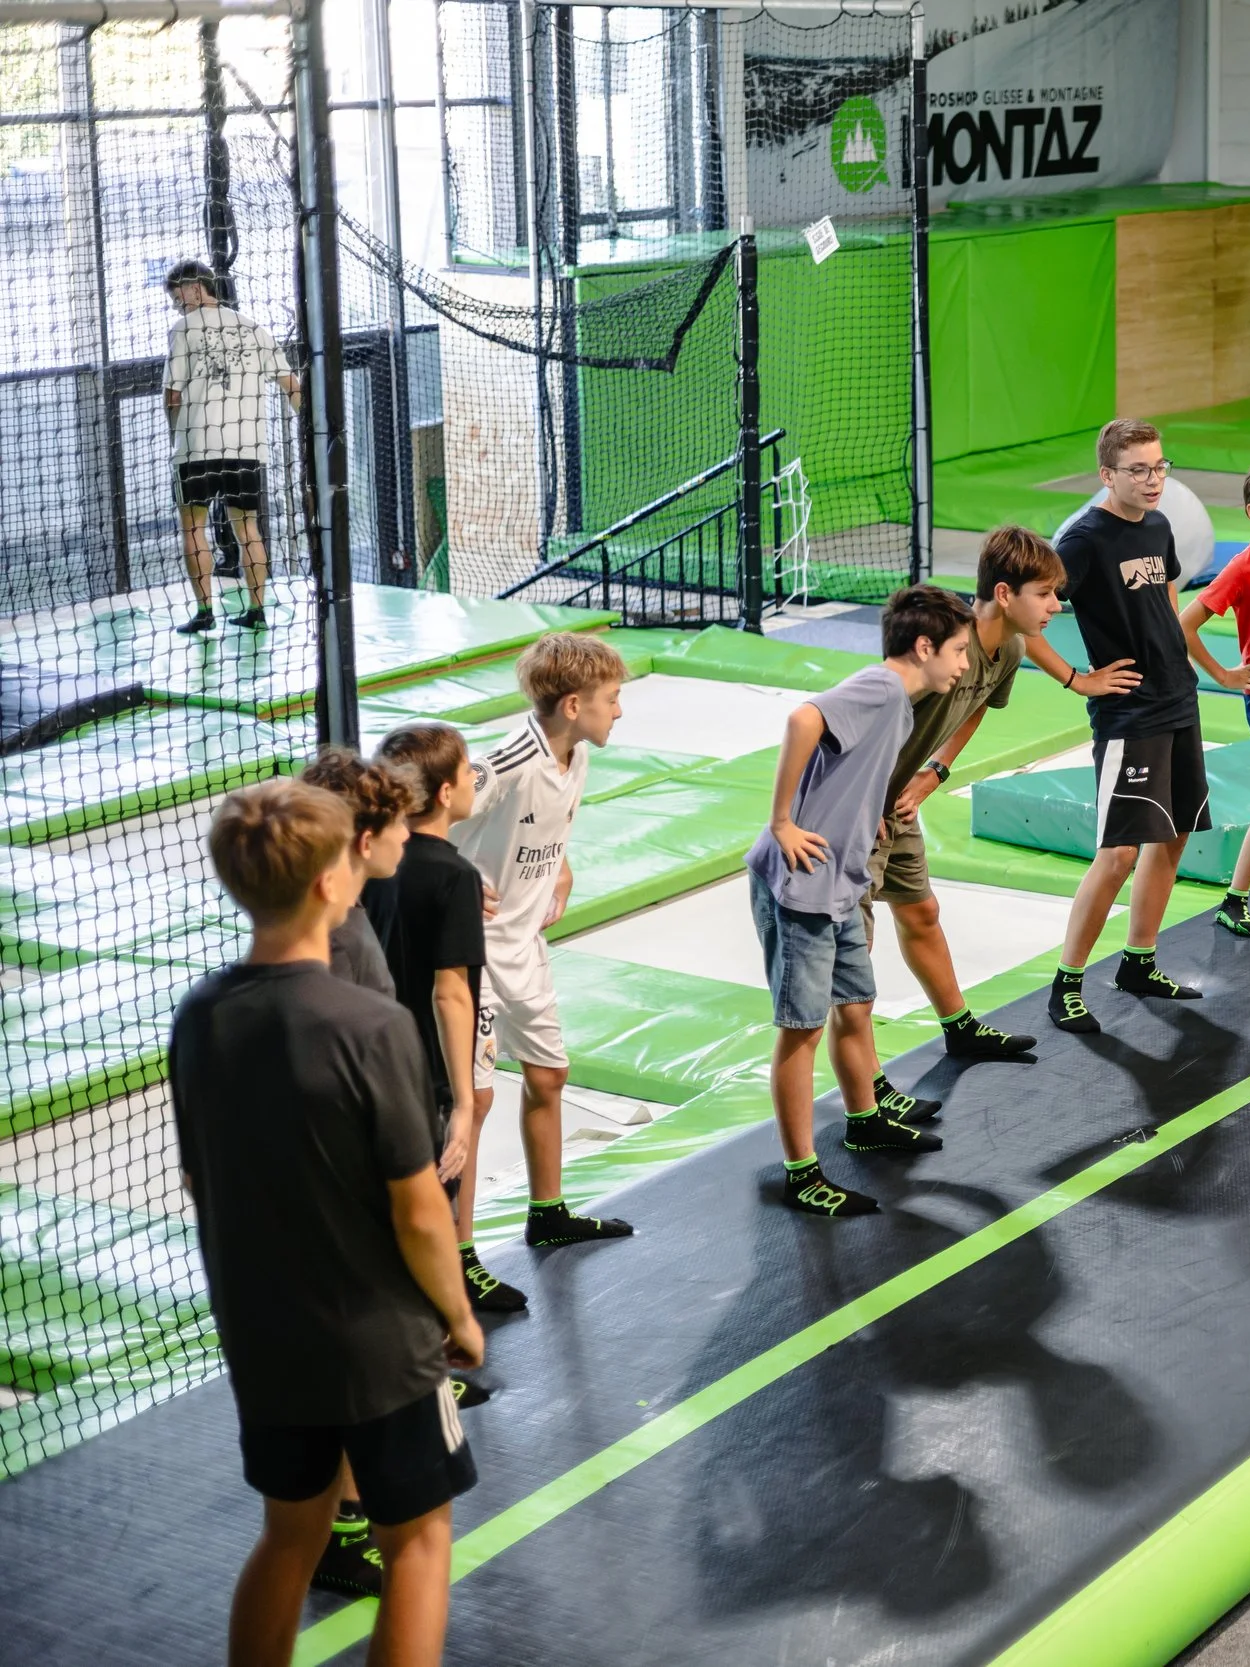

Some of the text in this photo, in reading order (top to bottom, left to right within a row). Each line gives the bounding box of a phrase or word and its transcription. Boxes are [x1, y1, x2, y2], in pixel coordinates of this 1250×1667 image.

[929, 91, 979, 108] ROSHOP
[983, 89, 1024, 105] GLISSE
[1040, 85, 1105, 102] MONTAGNE
